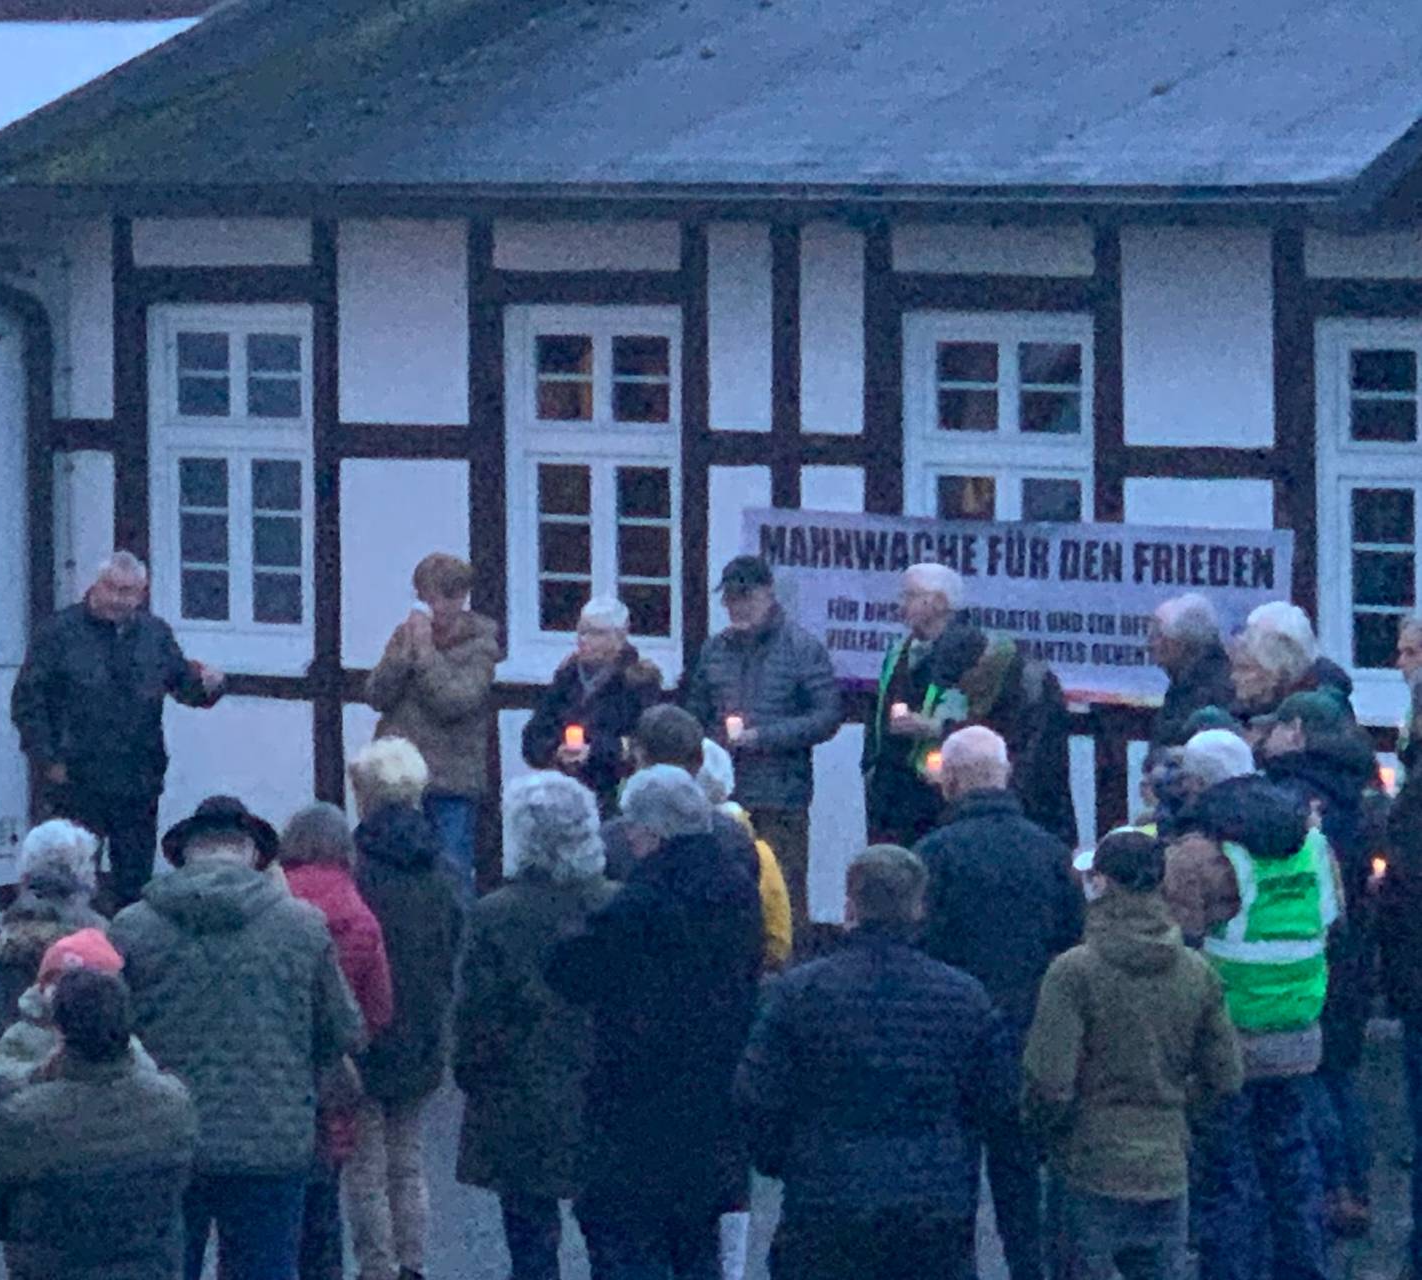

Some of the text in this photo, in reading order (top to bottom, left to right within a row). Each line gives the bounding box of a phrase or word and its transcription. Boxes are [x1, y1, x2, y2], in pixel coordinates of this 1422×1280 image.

[760, 524, 1275, 589] MAHNWACHE FÜR DEN FRIEDEN
